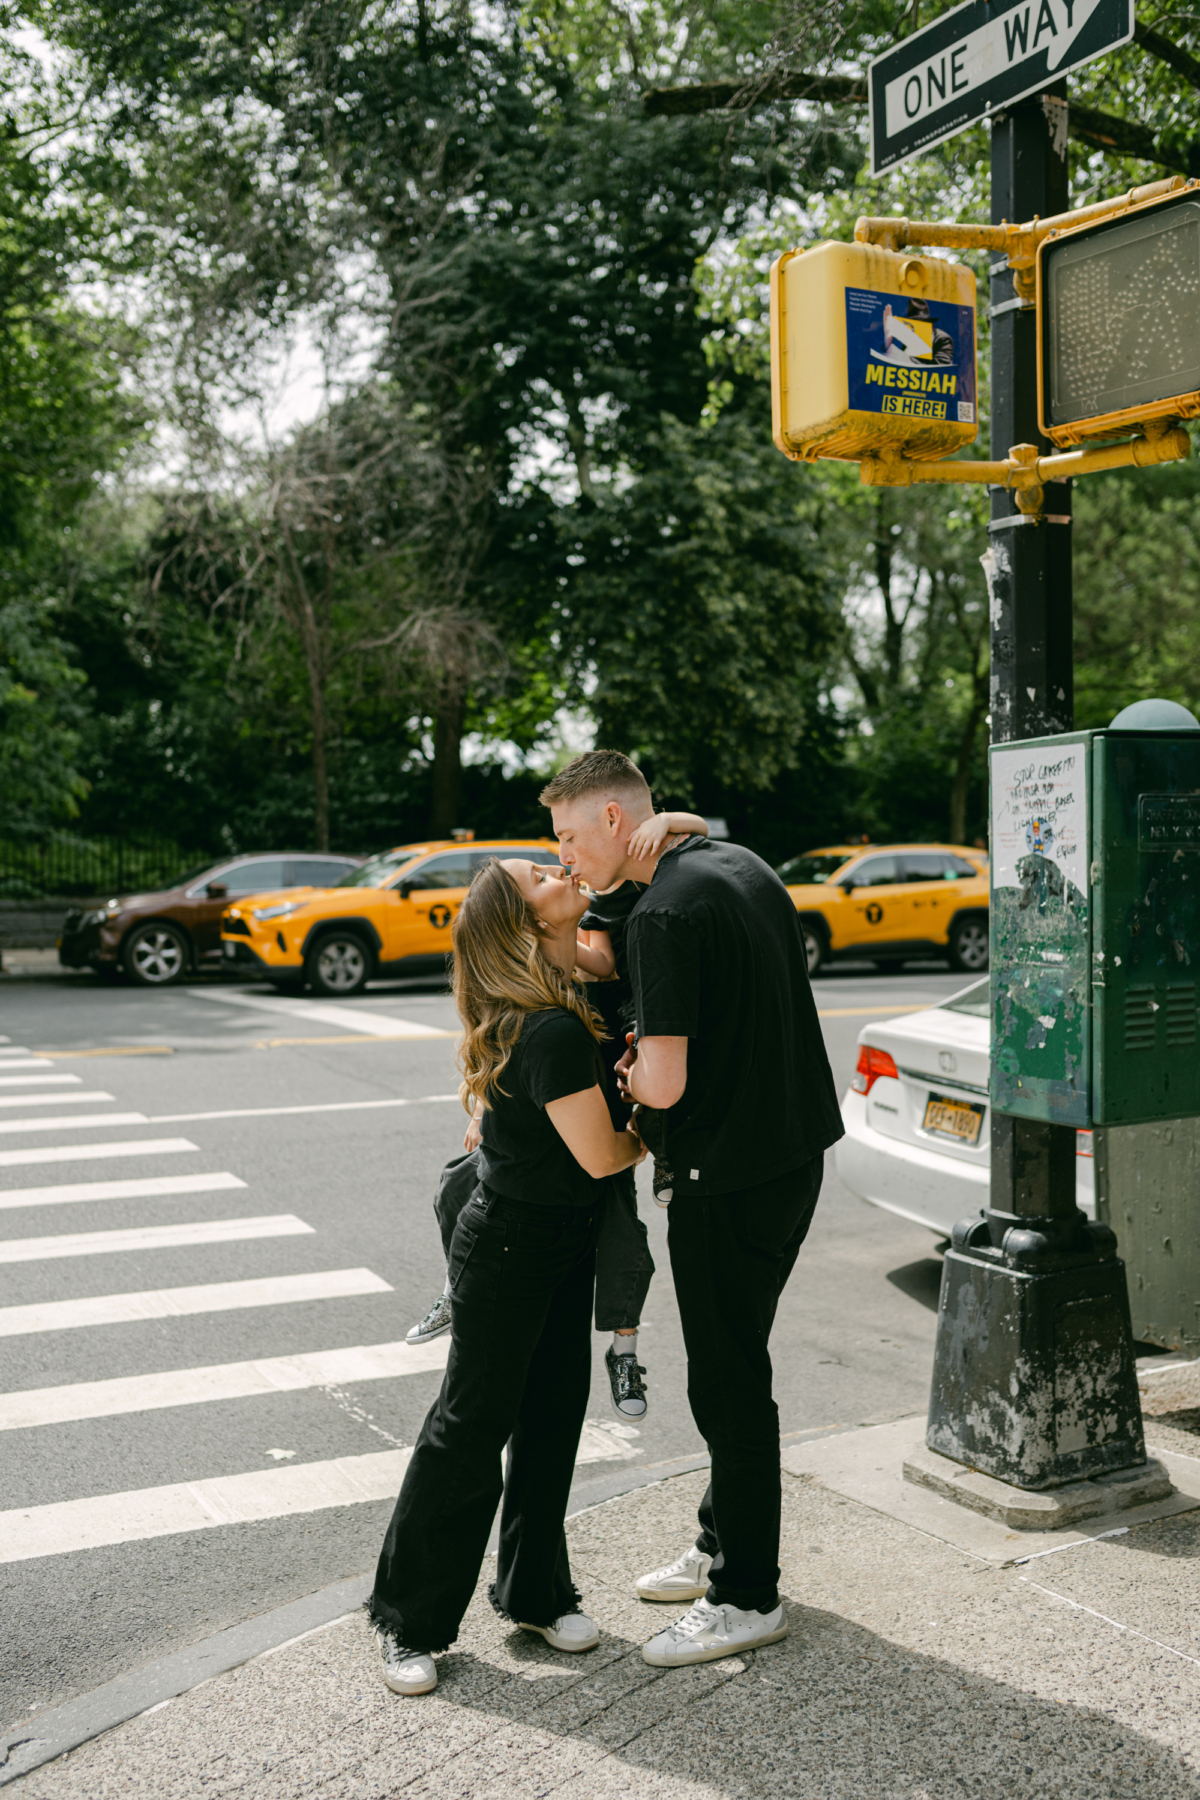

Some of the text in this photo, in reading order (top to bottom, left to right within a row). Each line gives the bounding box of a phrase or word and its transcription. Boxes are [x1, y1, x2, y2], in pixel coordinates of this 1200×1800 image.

[904, 0, 1076, 118] ONE WAY
[865, 363, 957, 395] MESSIAH
[883, 396, 945, 418] IS HERE!
[1013, 763, 1035, 788] STOP
